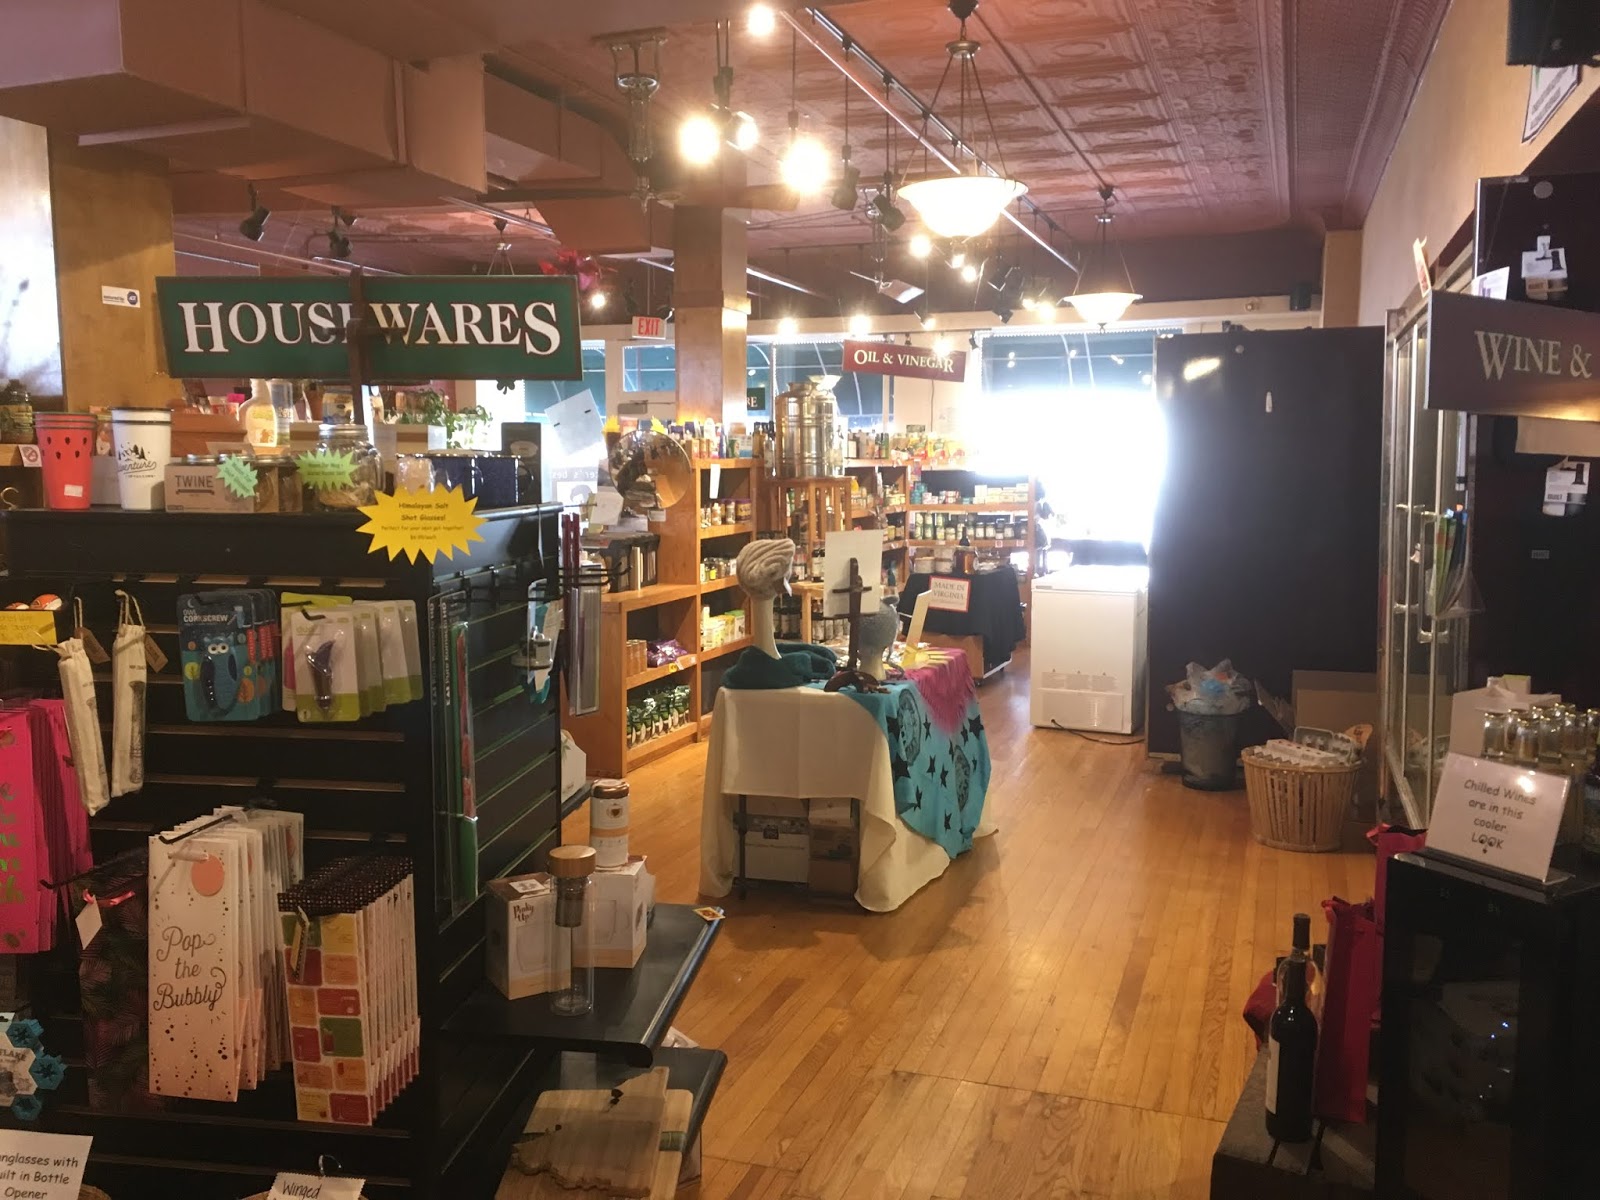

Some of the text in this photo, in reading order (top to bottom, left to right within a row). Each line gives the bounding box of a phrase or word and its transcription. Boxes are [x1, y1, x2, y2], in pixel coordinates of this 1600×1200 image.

[177, 301, 561, 356] HOUSWARES
[638, 317, 660, 336] EXIT
[854, 349, 954, 373] OIL & VINEGAR
[1474, 330, 1592, 381] WINE &
[175, 475, 214, 488] TWINE
[398, 502, 432, 510] Himalayan
[934, 581, 954, 590] MADE
[183, 615, 228, 623] CORKSCREW
[1463, 778, 1537, 805] Chilled Wines
[1468, 800, 1524, 820] are in this
[1473, 818, 1507, 832] cooler
[1471, 832, 1505, 850] LOOK
[513, 902, 535, 918] Pinky
[517, 913, 531, 923] Up
[156, 926, 216, 961] Pop
[174, 958, 202, 979] the
[153, 967, 226, 1011] Bubbly
[0, 1152, 79, 1168] nglasses with
[0, 1169, 70, 1185] uilt in Bottle
[4, 1186, 48, 1200] Opener
[282, 1180, 322, 1200] Winged
